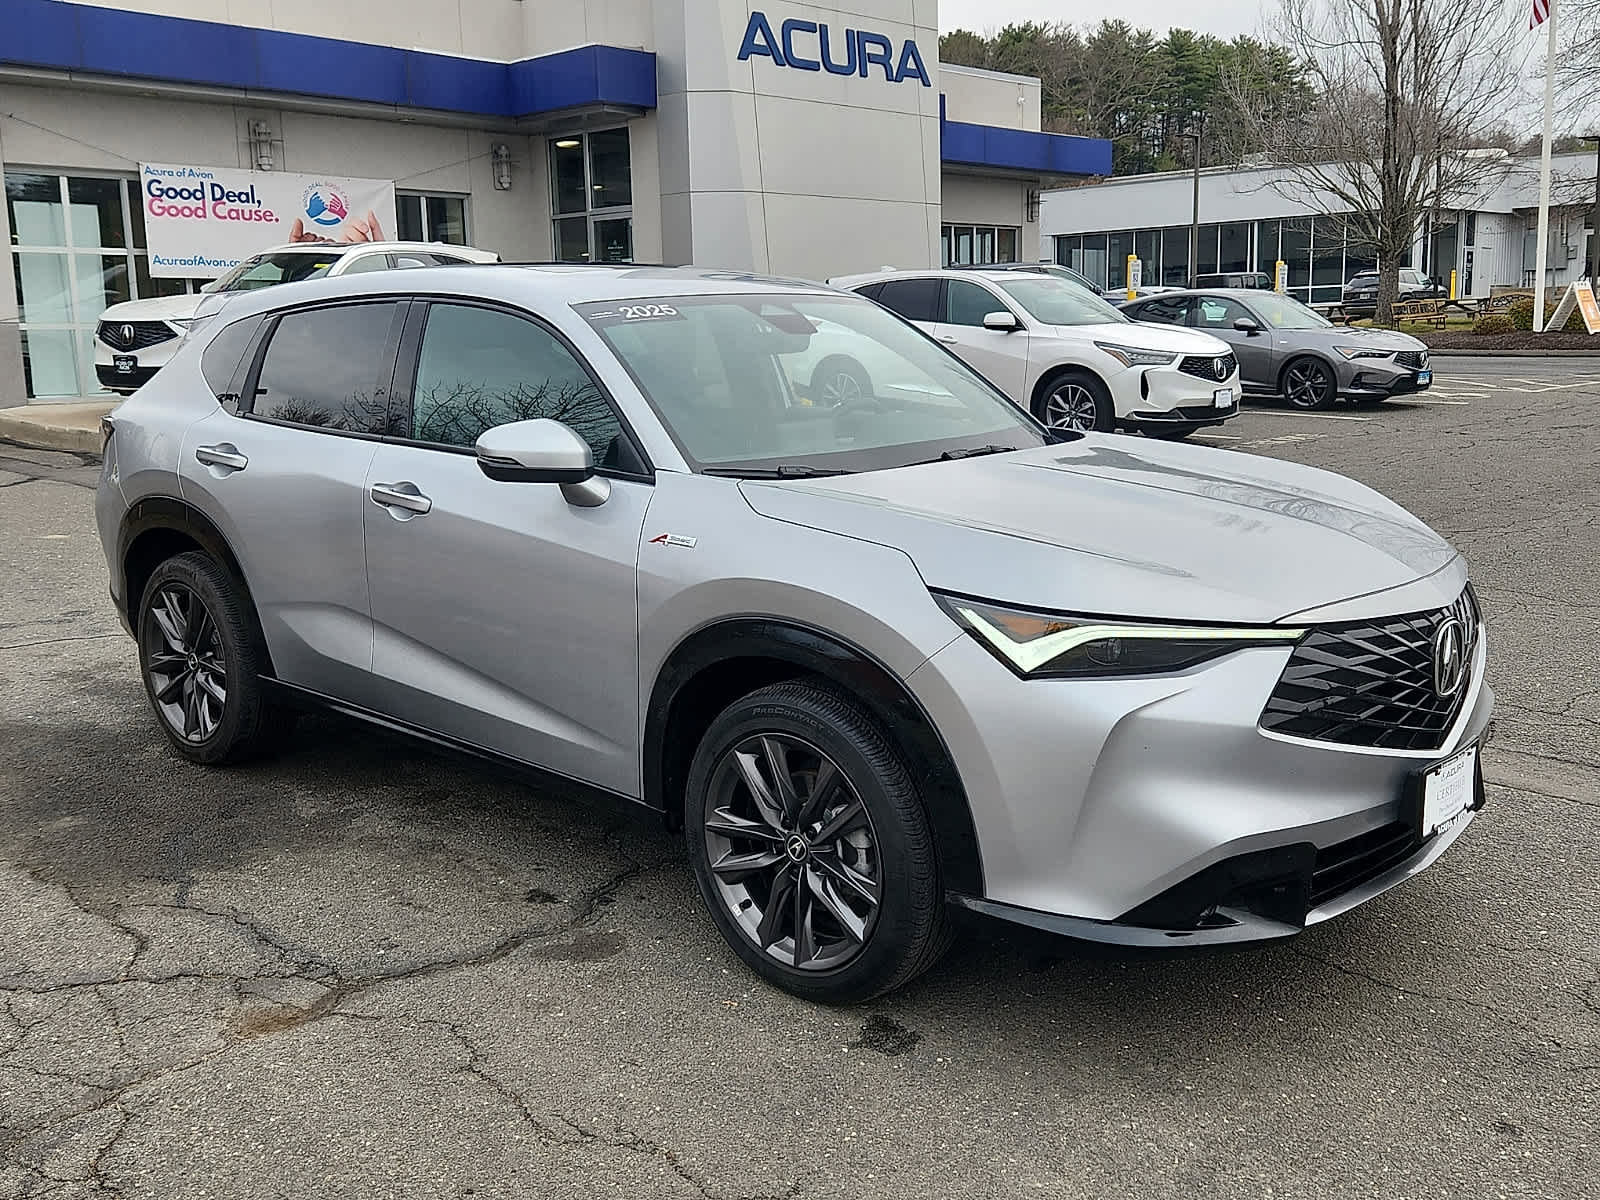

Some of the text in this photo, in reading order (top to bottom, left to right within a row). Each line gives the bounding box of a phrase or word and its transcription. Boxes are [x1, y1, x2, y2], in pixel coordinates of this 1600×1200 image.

[737, 11, 932, 87] ACURA
[144, 166, 214, 179] Acura of Avon
[147, 179, 262, 208] Good Deal,
[149, 197, 280, 223] Good Cause.
[618, 304, 678, 319] 2025
